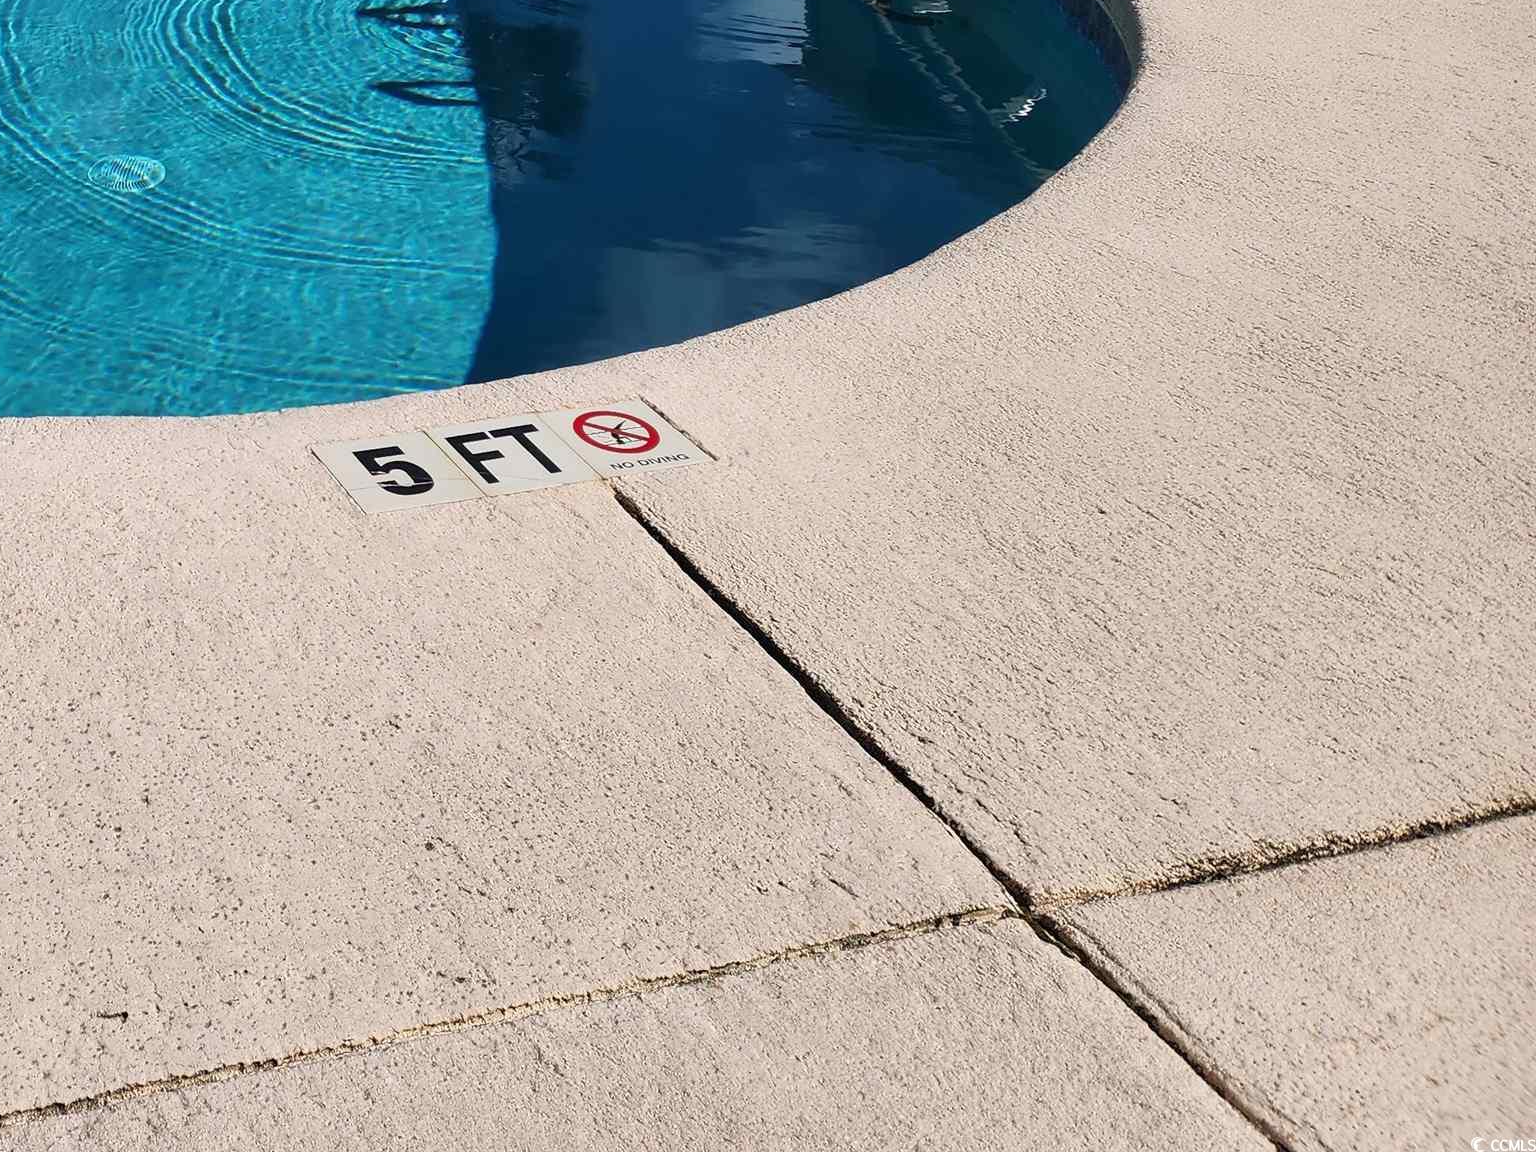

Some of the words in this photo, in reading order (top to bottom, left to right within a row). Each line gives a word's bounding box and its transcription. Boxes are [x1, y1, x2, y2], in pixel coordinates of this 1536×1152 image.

[351, 446, 435, 496] 5
[444, 423, 563, 485] FT
[609, 461, 635, 470] NO
[637, 453, 690, 466] DIVING
